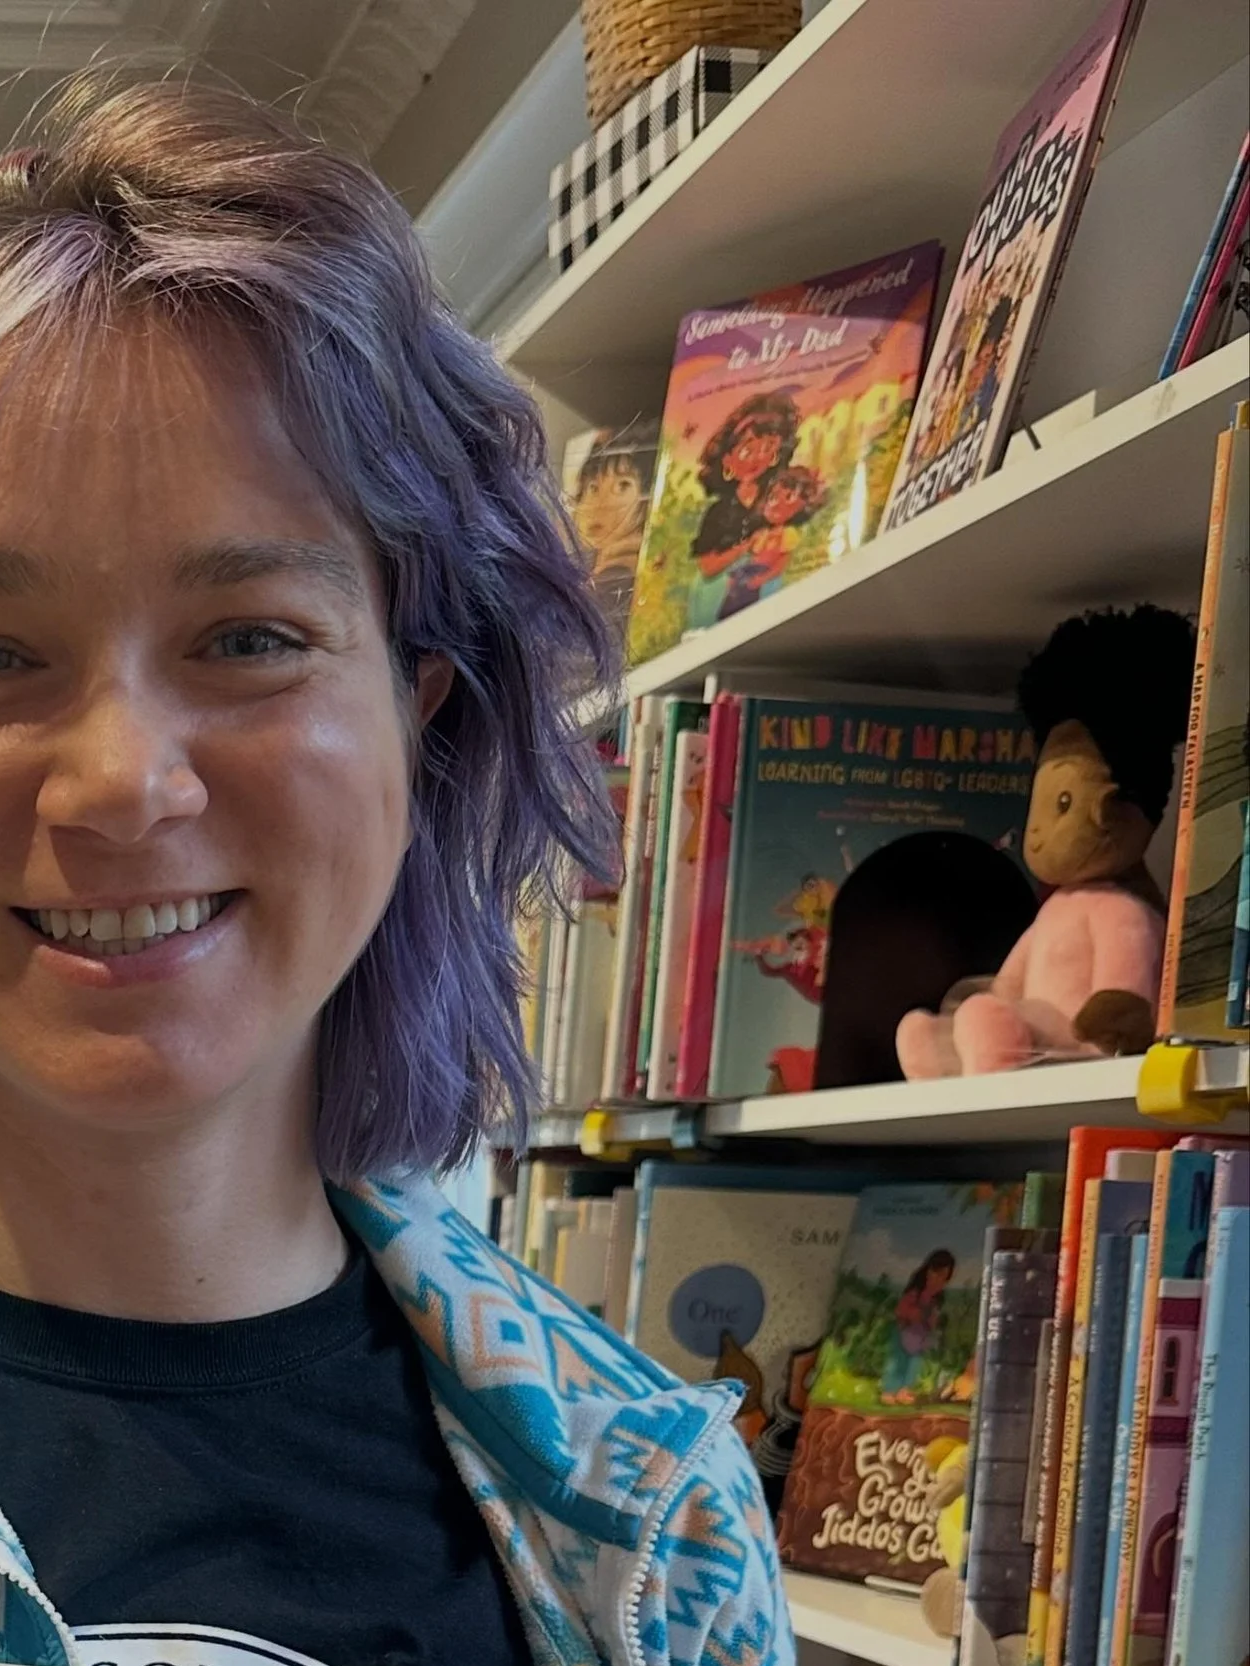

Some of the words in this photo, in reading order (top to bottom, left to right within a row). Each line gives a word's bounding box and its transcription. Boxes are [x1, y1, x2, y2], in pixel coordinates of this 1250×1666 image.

[969, 134, 1034, 259] OUR
[985, 143, 1072, 270] VOICES
[798, 257, 914, 318] Happened
[728, 346, 750, 370] to
[755, 335, 794, 373] My
[800, 318, 849, 355] Dad
[886, 419, 986, 529] TOGETHER
[759, 715, 834, 750] KIND
[841, 719, 904, 761] LIKE
[912, 724, 1038, 763] MARSHA
[758, 760, 845, 785] LEARNING
[851, 767, 887, 785] FROM
[790, 1228, 840, 1247] SAM
[687, 1300, 740, 1324] One
[989, 1274, 1005, 1314] Just
[1062, 1391, 1078, 1456] Century
[854, 1431, 931, 1497] Every
[812, 1503, 903, 1554] Jiddo's
[1052, 1488, 1070, 1556] Caroline
